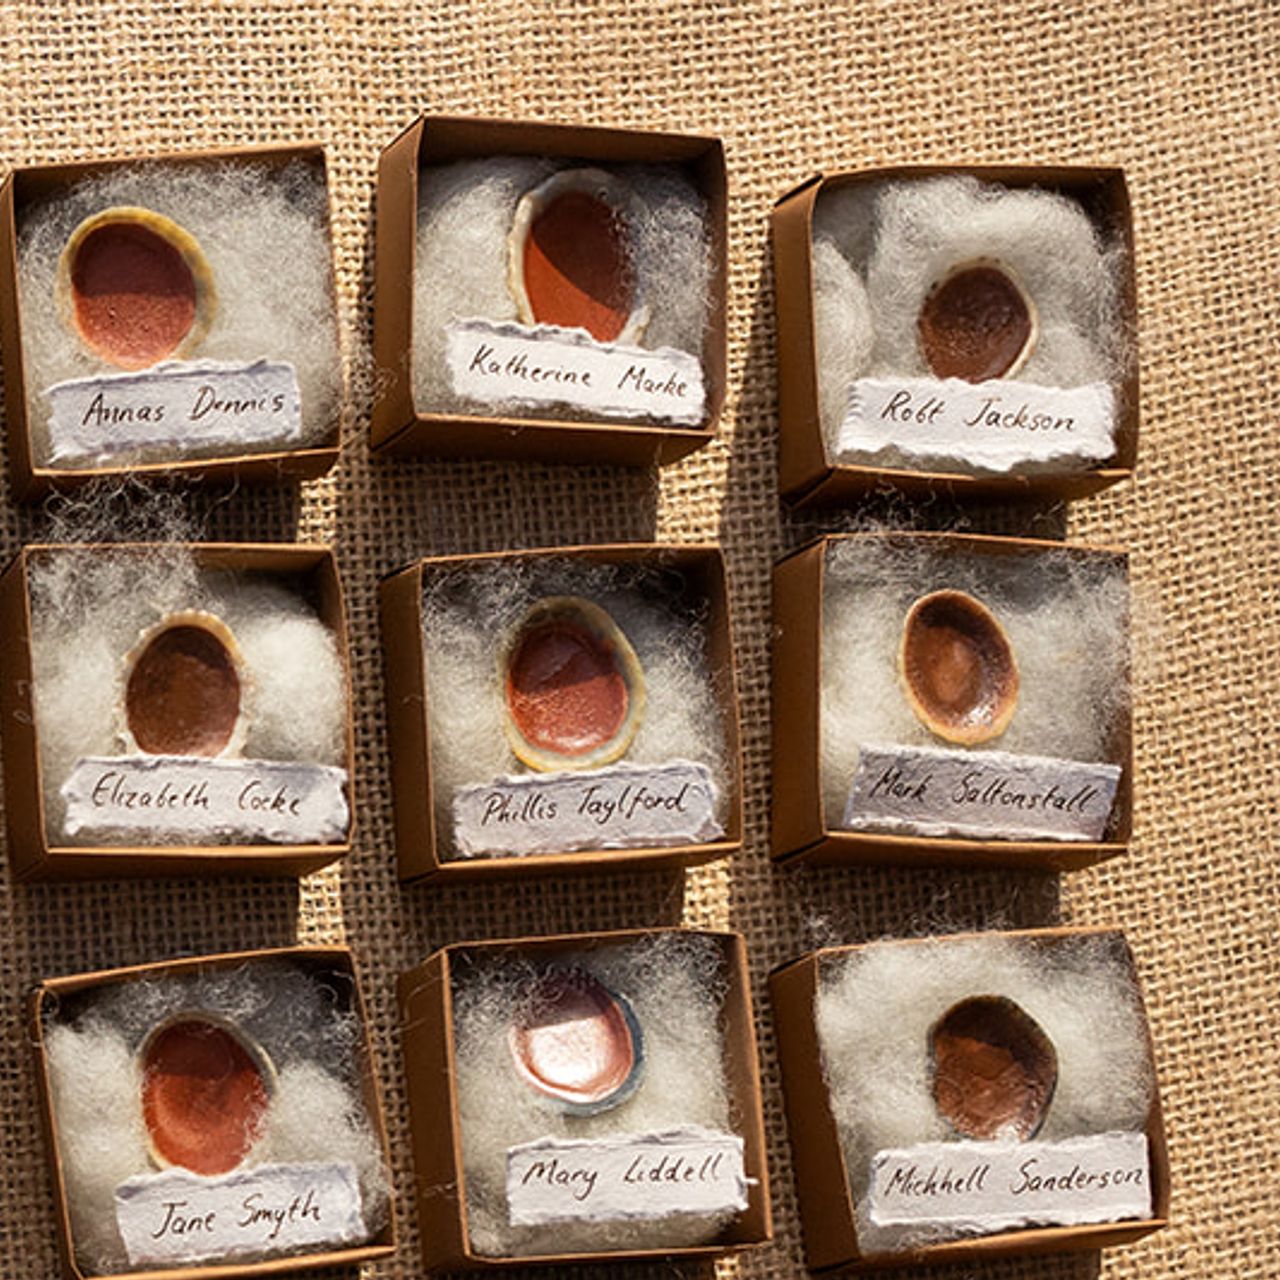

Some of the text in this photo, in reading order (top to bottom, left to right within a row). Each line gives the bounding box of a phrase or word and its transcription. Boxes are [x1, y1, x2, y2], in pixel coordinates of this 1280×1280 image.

[470, 345, 688, 396] Katherine Marke
[82, 388, 284, 425] Annas Dennis
[964, 398, 1074, 433] Jackson
[91, 772, 209, 808] Elizabeth
[482, 784, 687, 827] Phillis Taylford
[952, 772, 1098, 811] Saltonstall
[522, 1154, 721, 1200] Mary Liddell
[1010, 1161, 1142, 1193] Sanderson
[153, 1192, 321, 1238] Jane Smyth
